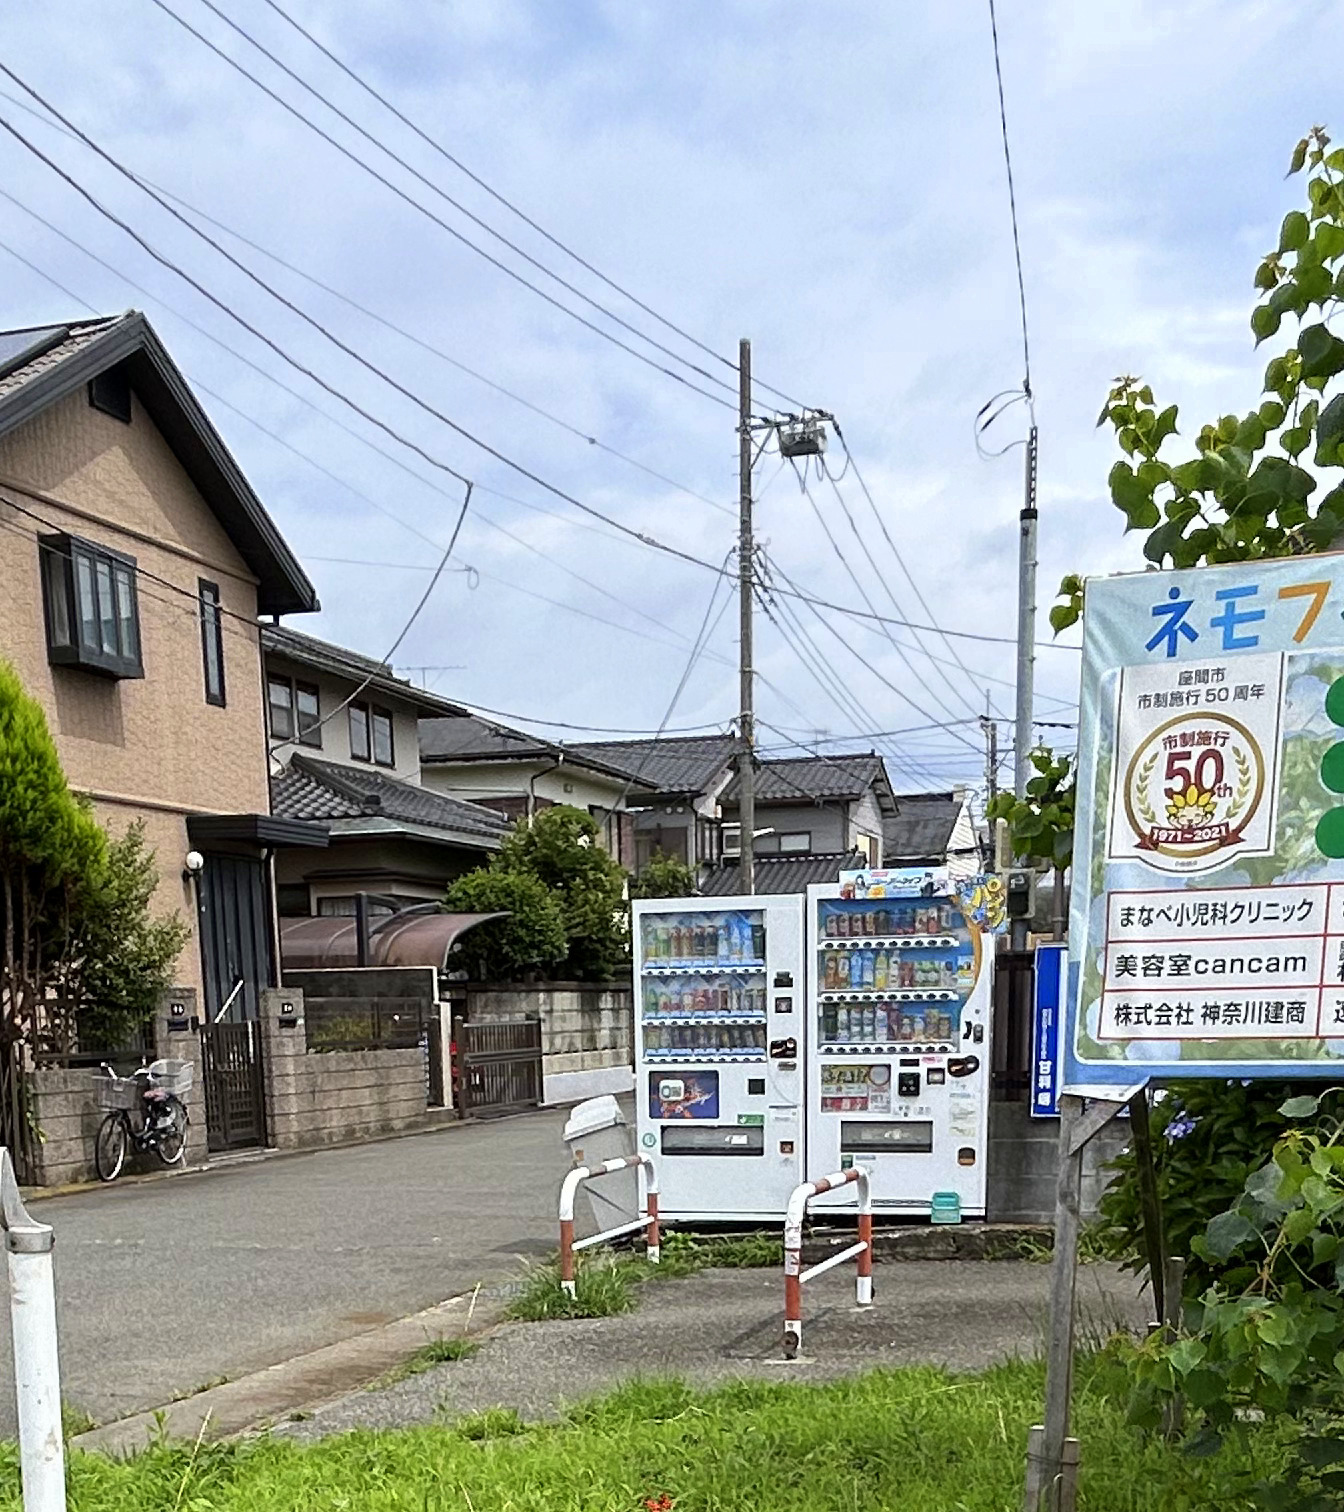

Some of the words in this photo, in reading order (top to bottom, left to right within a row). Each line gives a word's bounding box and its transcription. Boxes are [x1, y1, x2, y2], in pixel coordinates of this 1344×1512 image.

[1178, 668, 1226, 686] 座間市
[1120, 899, 1313, 927] まなべ小児科クリニック
[1115, 954, 1307, 978] 美容室cancam
[1115, 1003, 1194, 1027] 株式会社
[1201, 999, 1307, 1026] 神奈川建商
